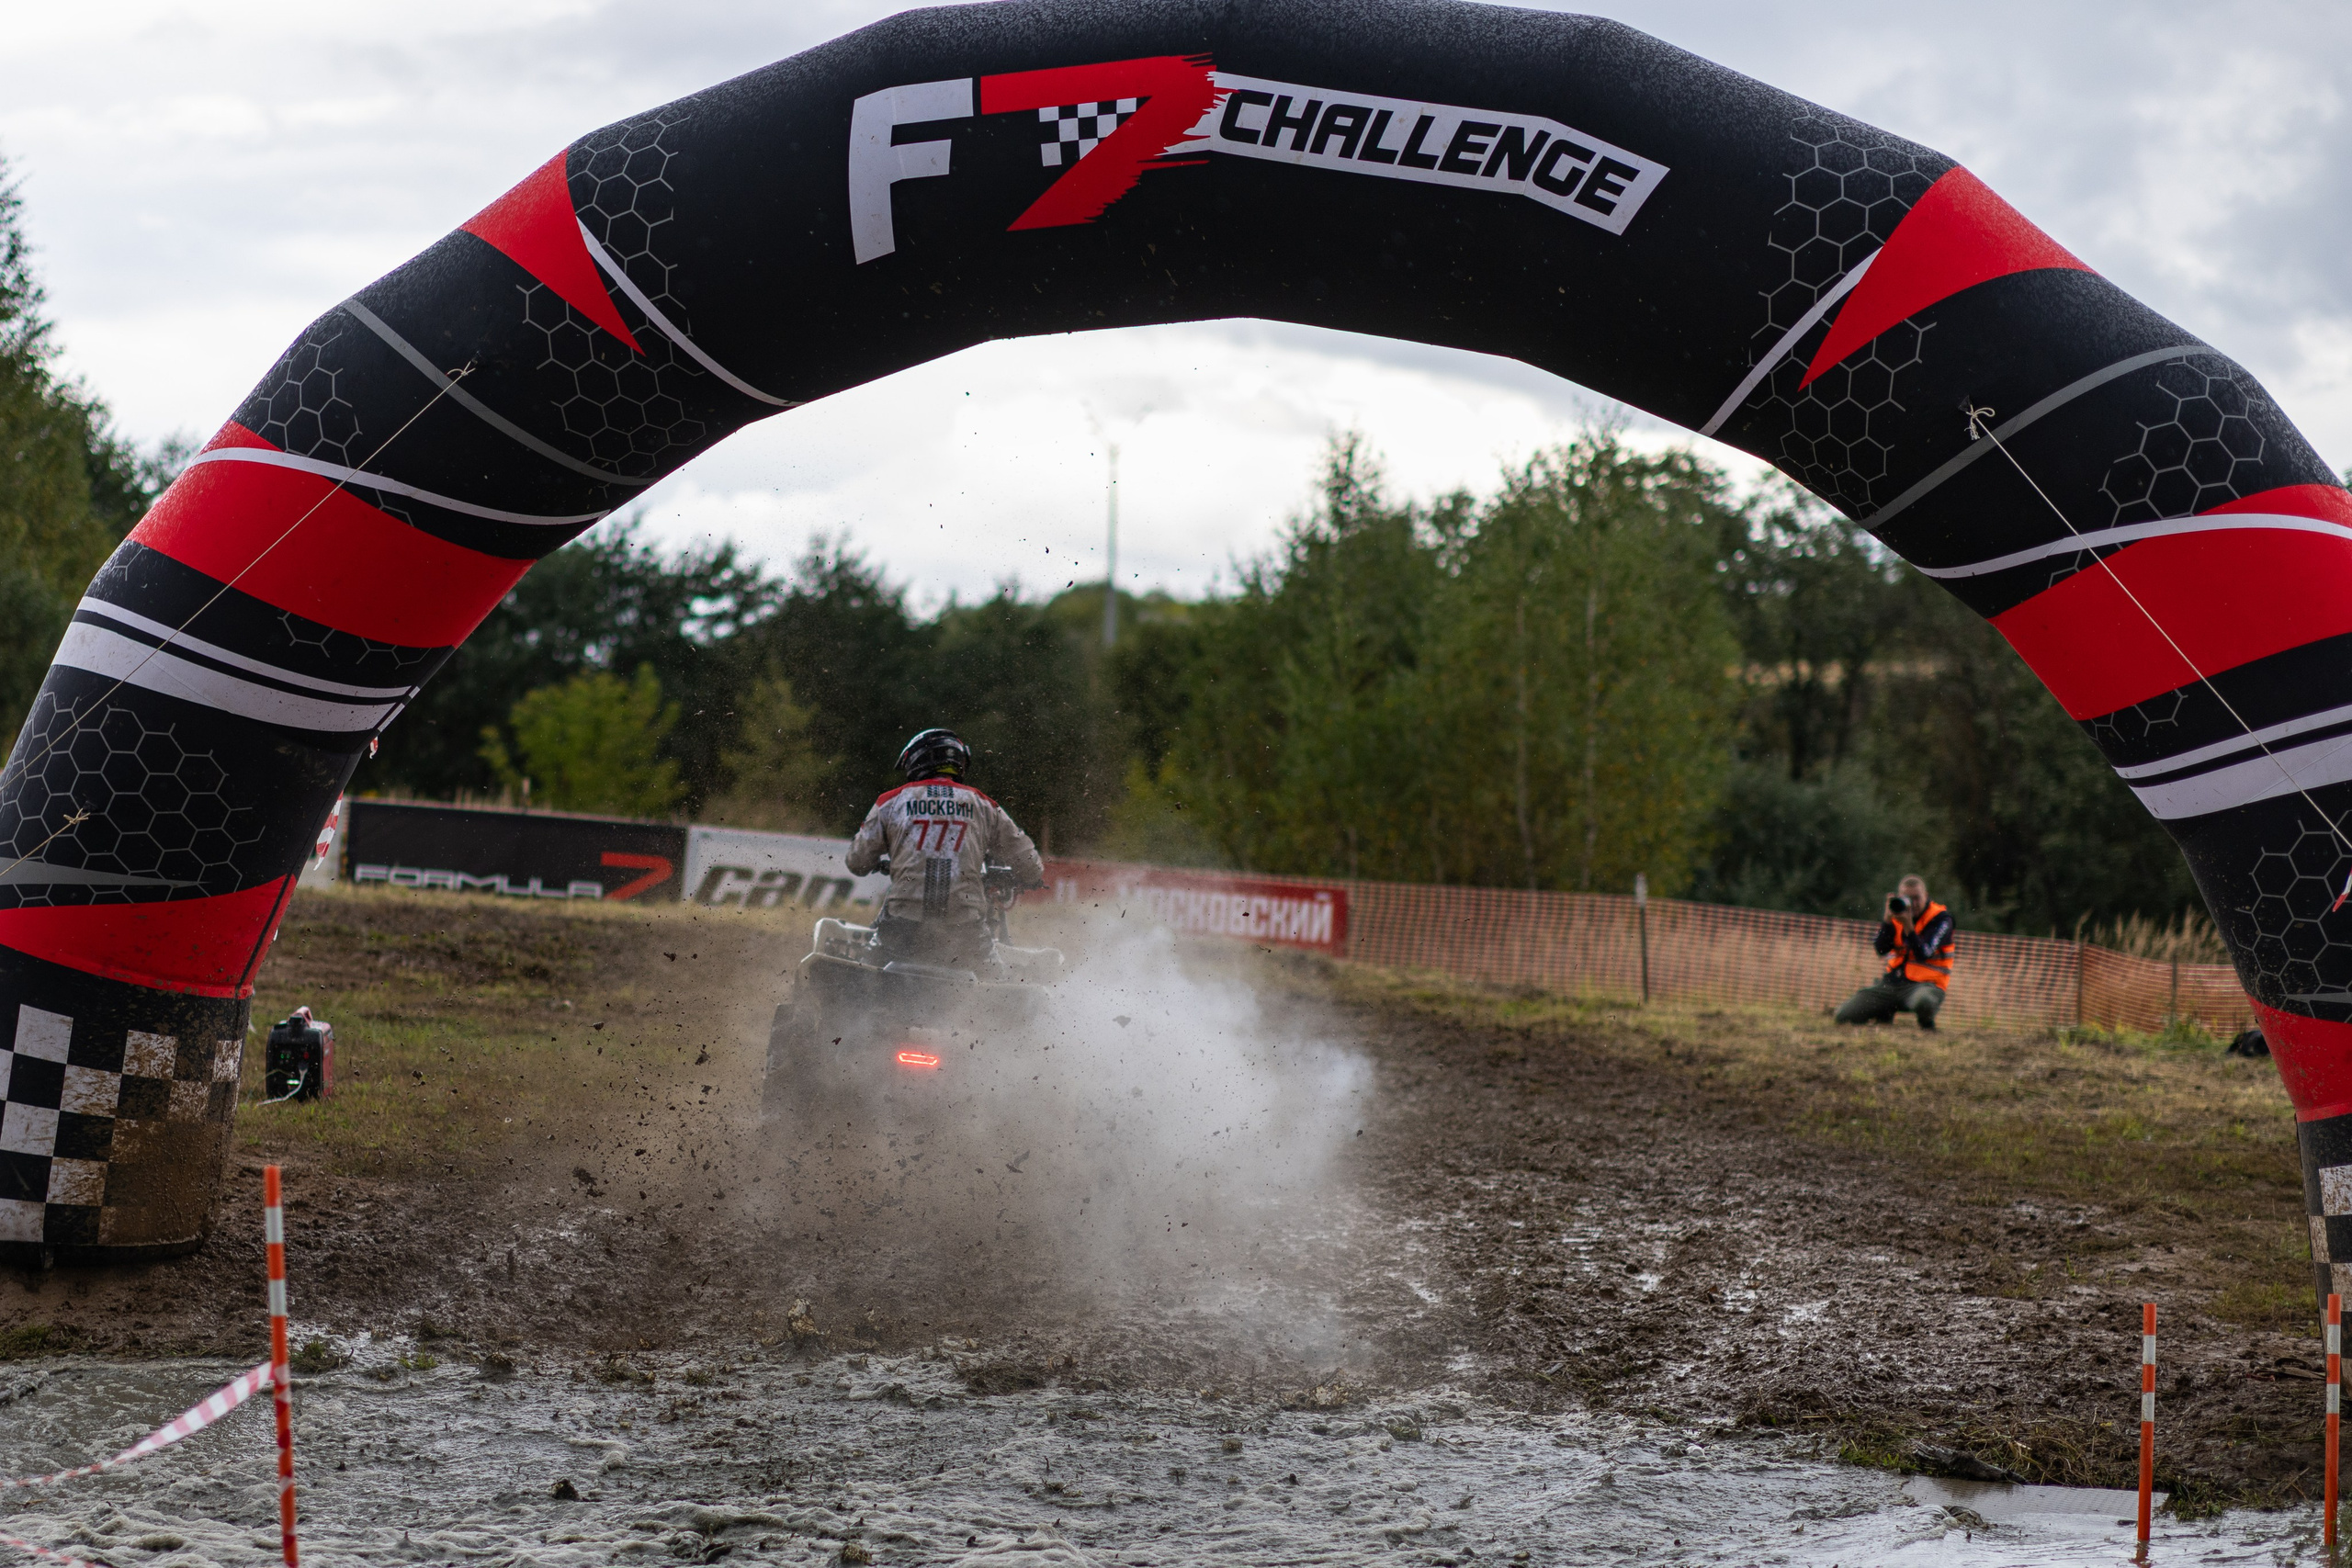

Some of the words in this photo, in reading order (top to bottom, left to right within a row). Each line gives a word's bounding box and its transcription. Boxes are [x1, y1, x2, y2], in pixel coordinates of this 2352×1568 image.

[1219, 88, 1641, 213] CHALLENGE
[906, 799, 974, 818] МОСКВИН
[912, 819, 968, 852] 777
[354, 863, 604, 899] FORMULA
